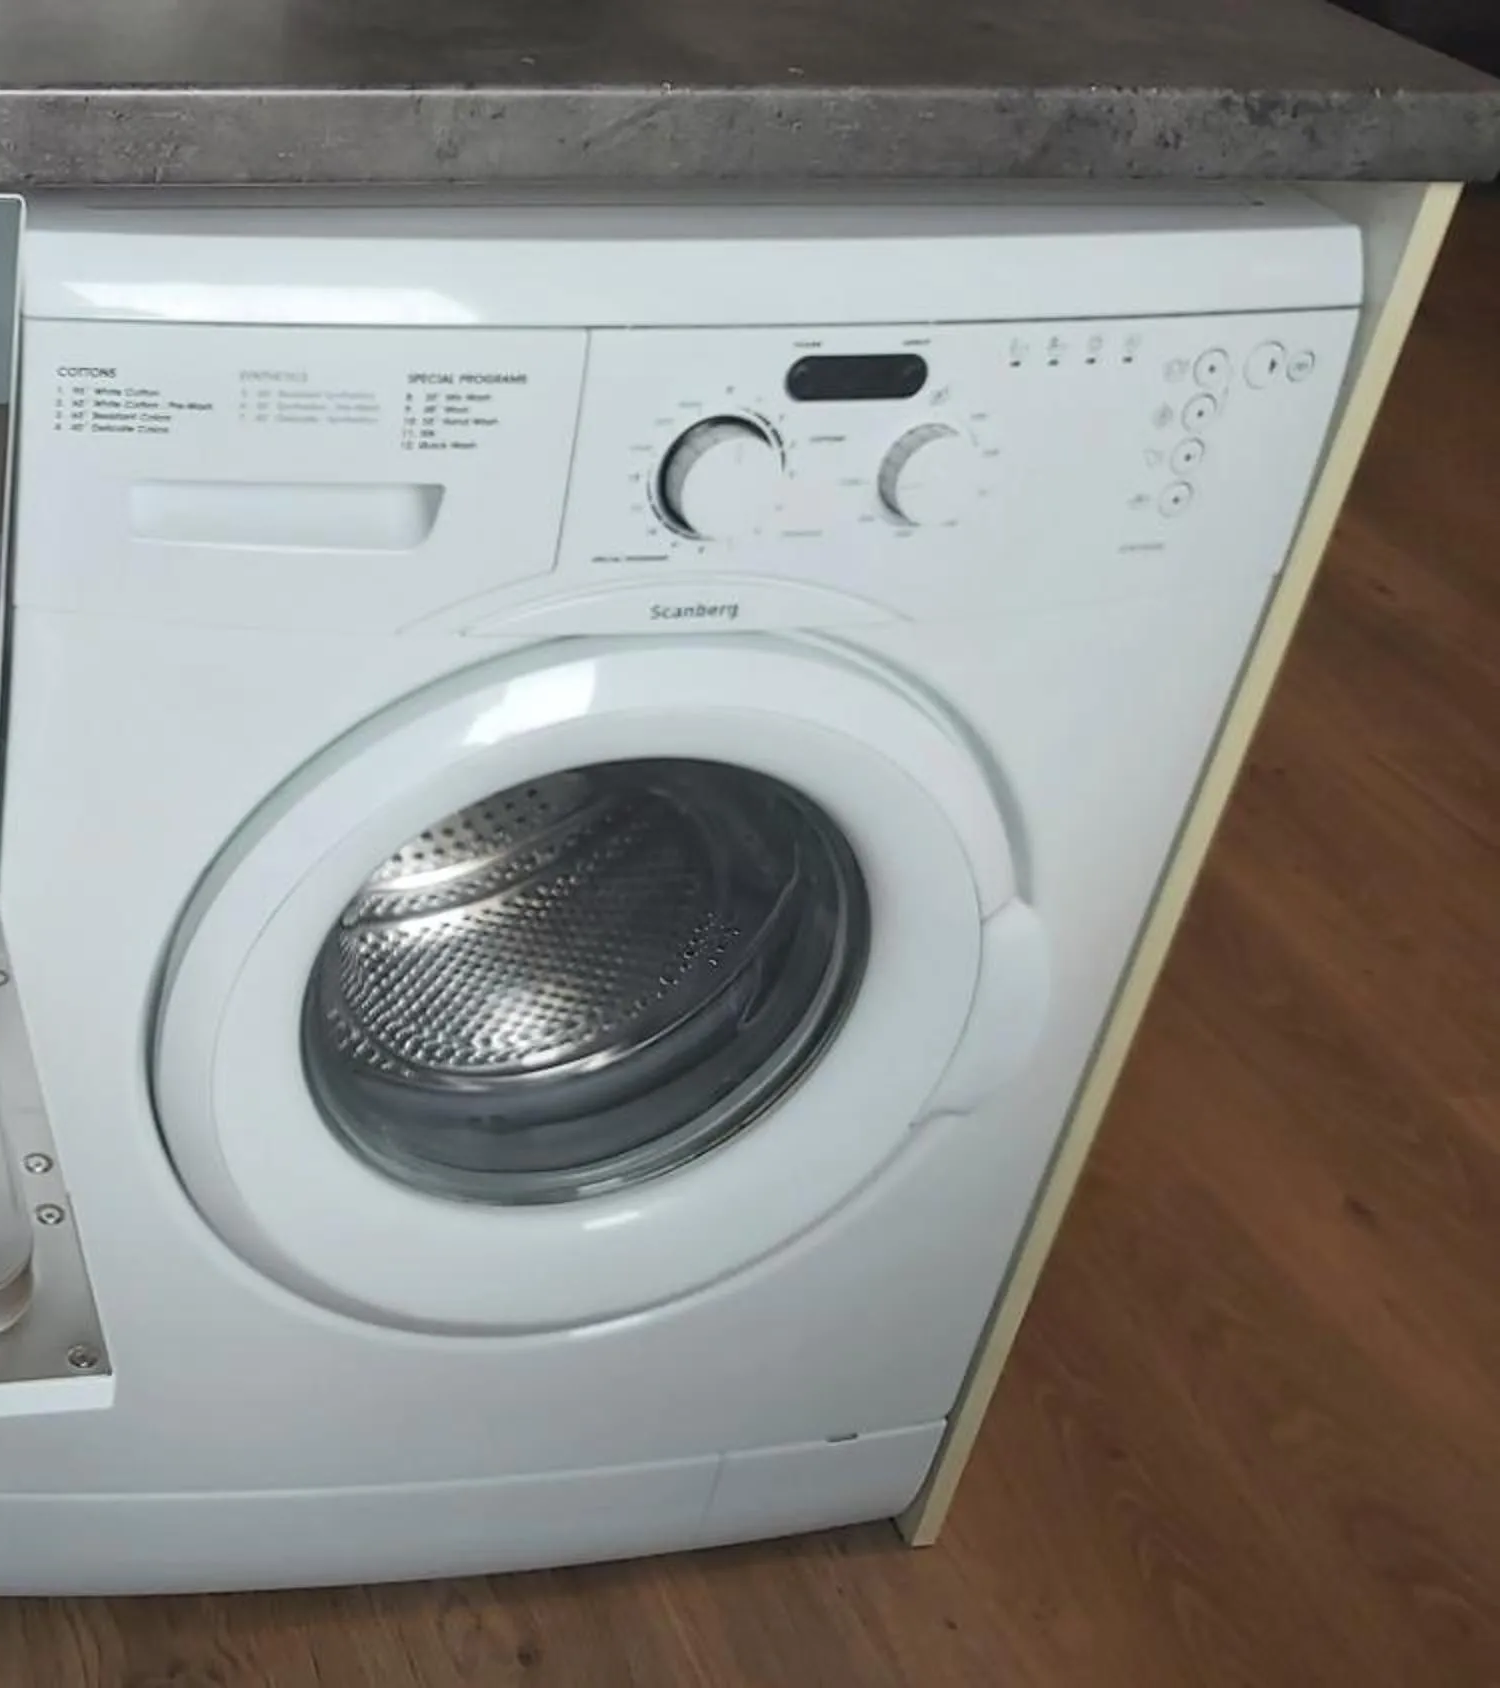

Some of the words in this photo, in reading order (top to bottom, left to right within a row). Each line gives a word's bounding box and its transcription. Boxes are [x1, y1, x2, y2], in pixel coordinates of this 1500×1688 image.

[57, 367, 117, 379] COTTONS
[407, 373, 453, 385] SPECIAL
[649, 602, 740, 621] Scanberg
